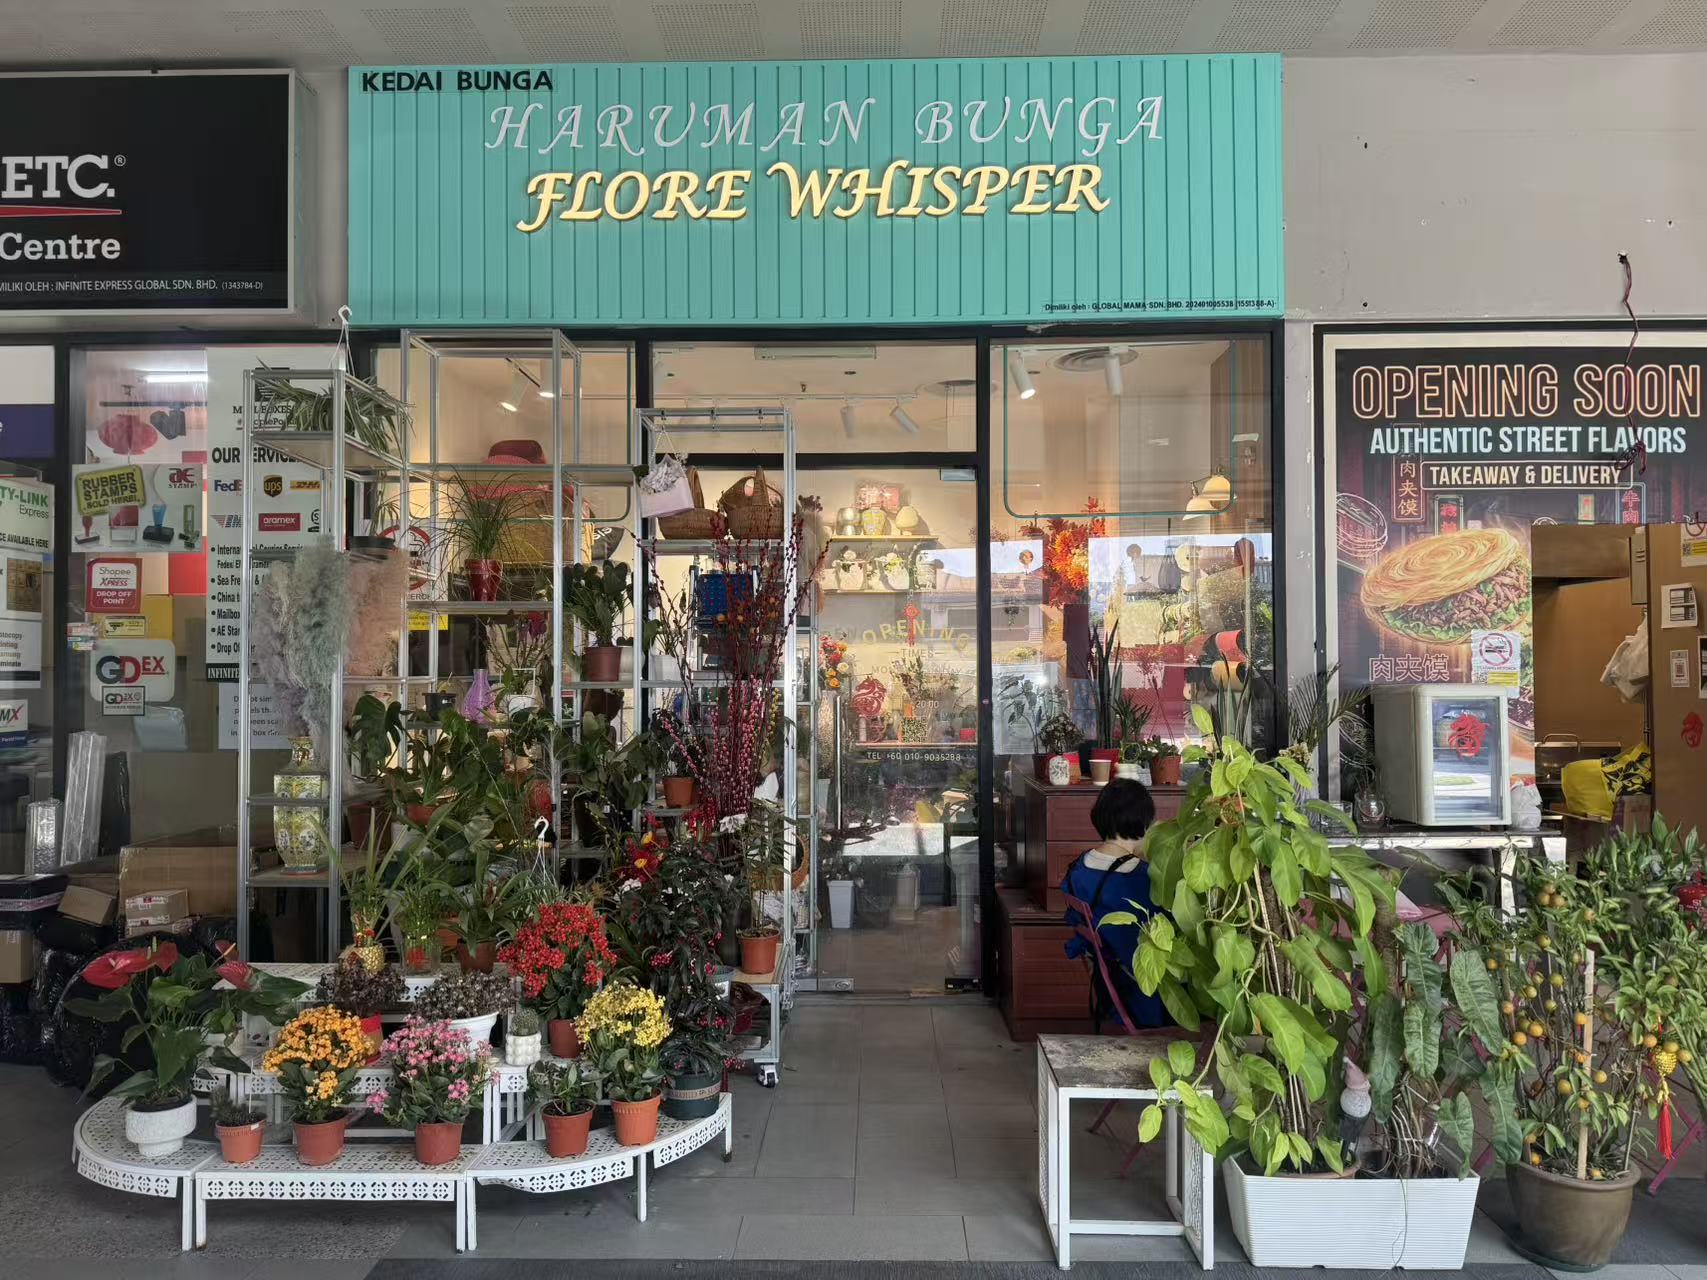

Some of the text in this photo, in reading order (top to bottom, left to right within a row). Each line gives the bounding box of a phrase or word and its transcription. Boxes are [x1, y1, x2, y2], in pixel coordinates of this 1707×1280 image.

[362, 70, 554, 92] KEDAI BUNGA
[485, 95, 1165, 157] HARUMAN BUNGA
[515, 159, 1112, 233] FLORE WHISPER
[0, 232, 121, 260] Centre
[25, 281, 49, 292] OLEH
[55, 280, 92, 291] INFINITE
[94, 280, 133, 290] EXPRESS
[134, 280, 170, 290] GLOBAL
[172, 280, 194, 290] SDN.
[196, 280, 218, 290] BHD.
[1092, 302, 1121, 310] GLOBAL
[1123, 301, 1146, 309] MAMA
[1149, 301, 1166, 309] SDN.
[1353, 364, 1700, 419] OPENING SOON
[1370, 426, 1687, 454] AUTHENTIC STREET FLAVORS
[212, 447, 241, 463] OUR
[82, 472, 136, 490] RUBBER
[1429, 465, 1621, 485] TAKEAWAY & DELIVERY
[83, 482, 138, 501] STAMPS
[264, 483, 281, 494] ups
[1398, 460, 1419, 516] 肉夹馍
[86, 499, 110, 508] SOLD
[19, 504, 49, 518] Express
[263, 515, 296, 524] aramex
[8, 534, 35, 546] AVAILABLE
[36, 538, 48, 548] HERE
[99, 567, 131, 577] Shopee
[217, 575, 229, 586] Sea
[217, 592, 233, 603] China
[217, 625, 225, 636] AE
[217, 642, 231, 655] Drop
[900, 647, 934, 659] TIMES
[1369, 653, 1450, 681] 肉夹馍
[867, 751, 881, 760] TEL
